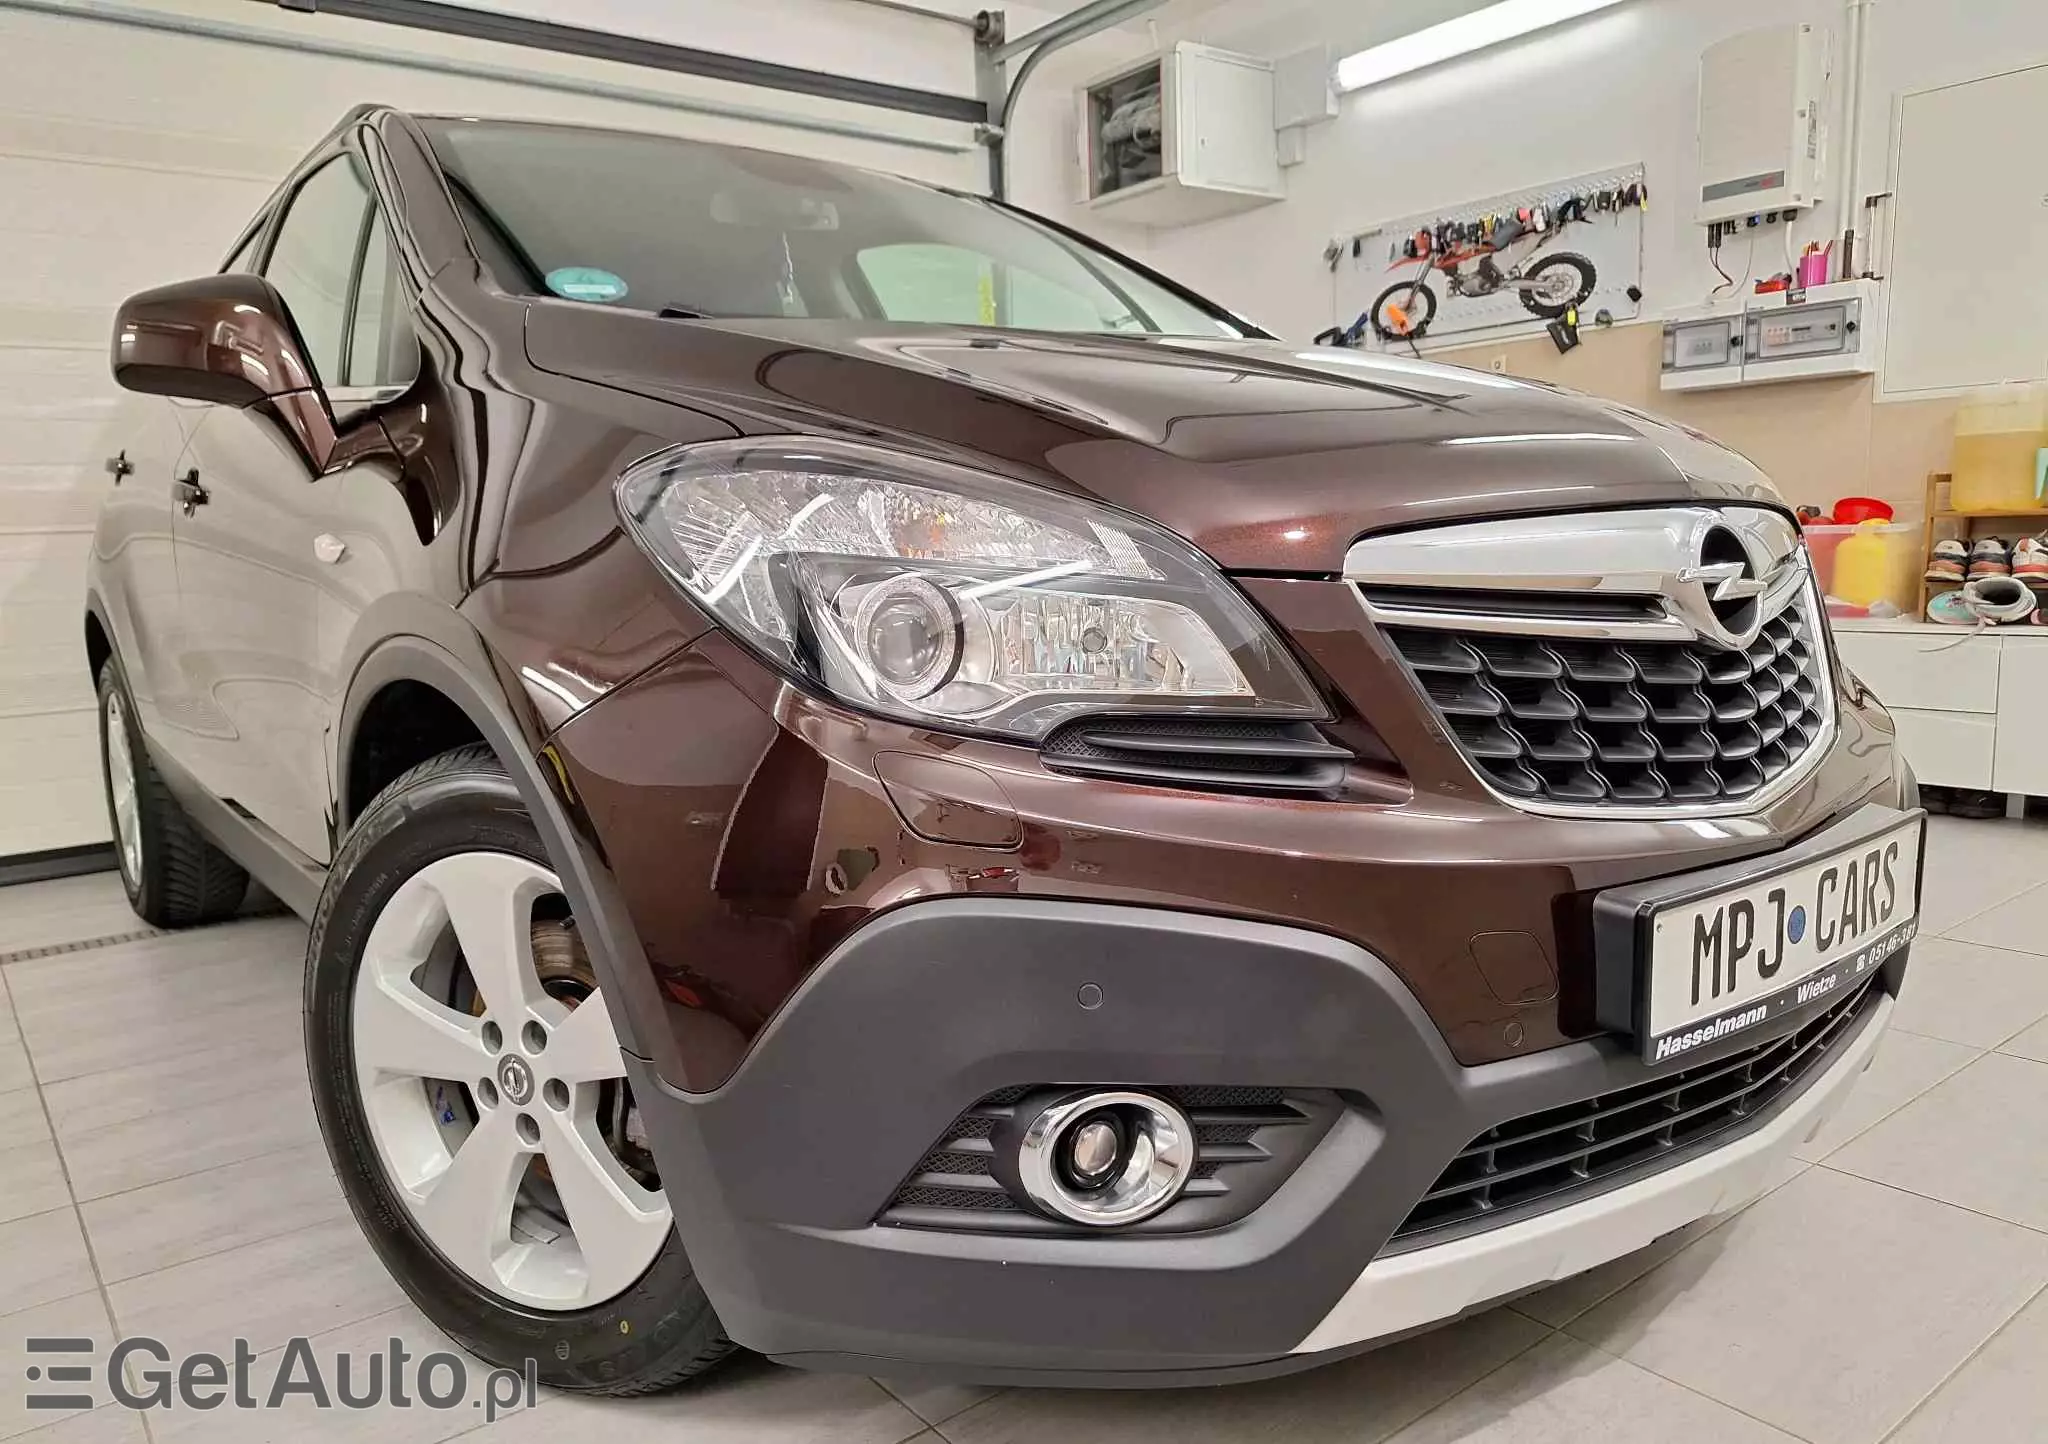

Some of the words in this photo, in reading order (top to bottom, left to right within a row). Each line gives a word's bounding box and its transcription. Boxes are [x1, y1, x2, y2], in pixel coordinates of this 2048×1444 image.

[1691, 887, 1786, 1006] MPJ
[1816, 841, 1898, 952] CARS
[1655, 1005, 1767, 1060] Hasselmann
[1797, 974, 1836, 1004] Wietze
